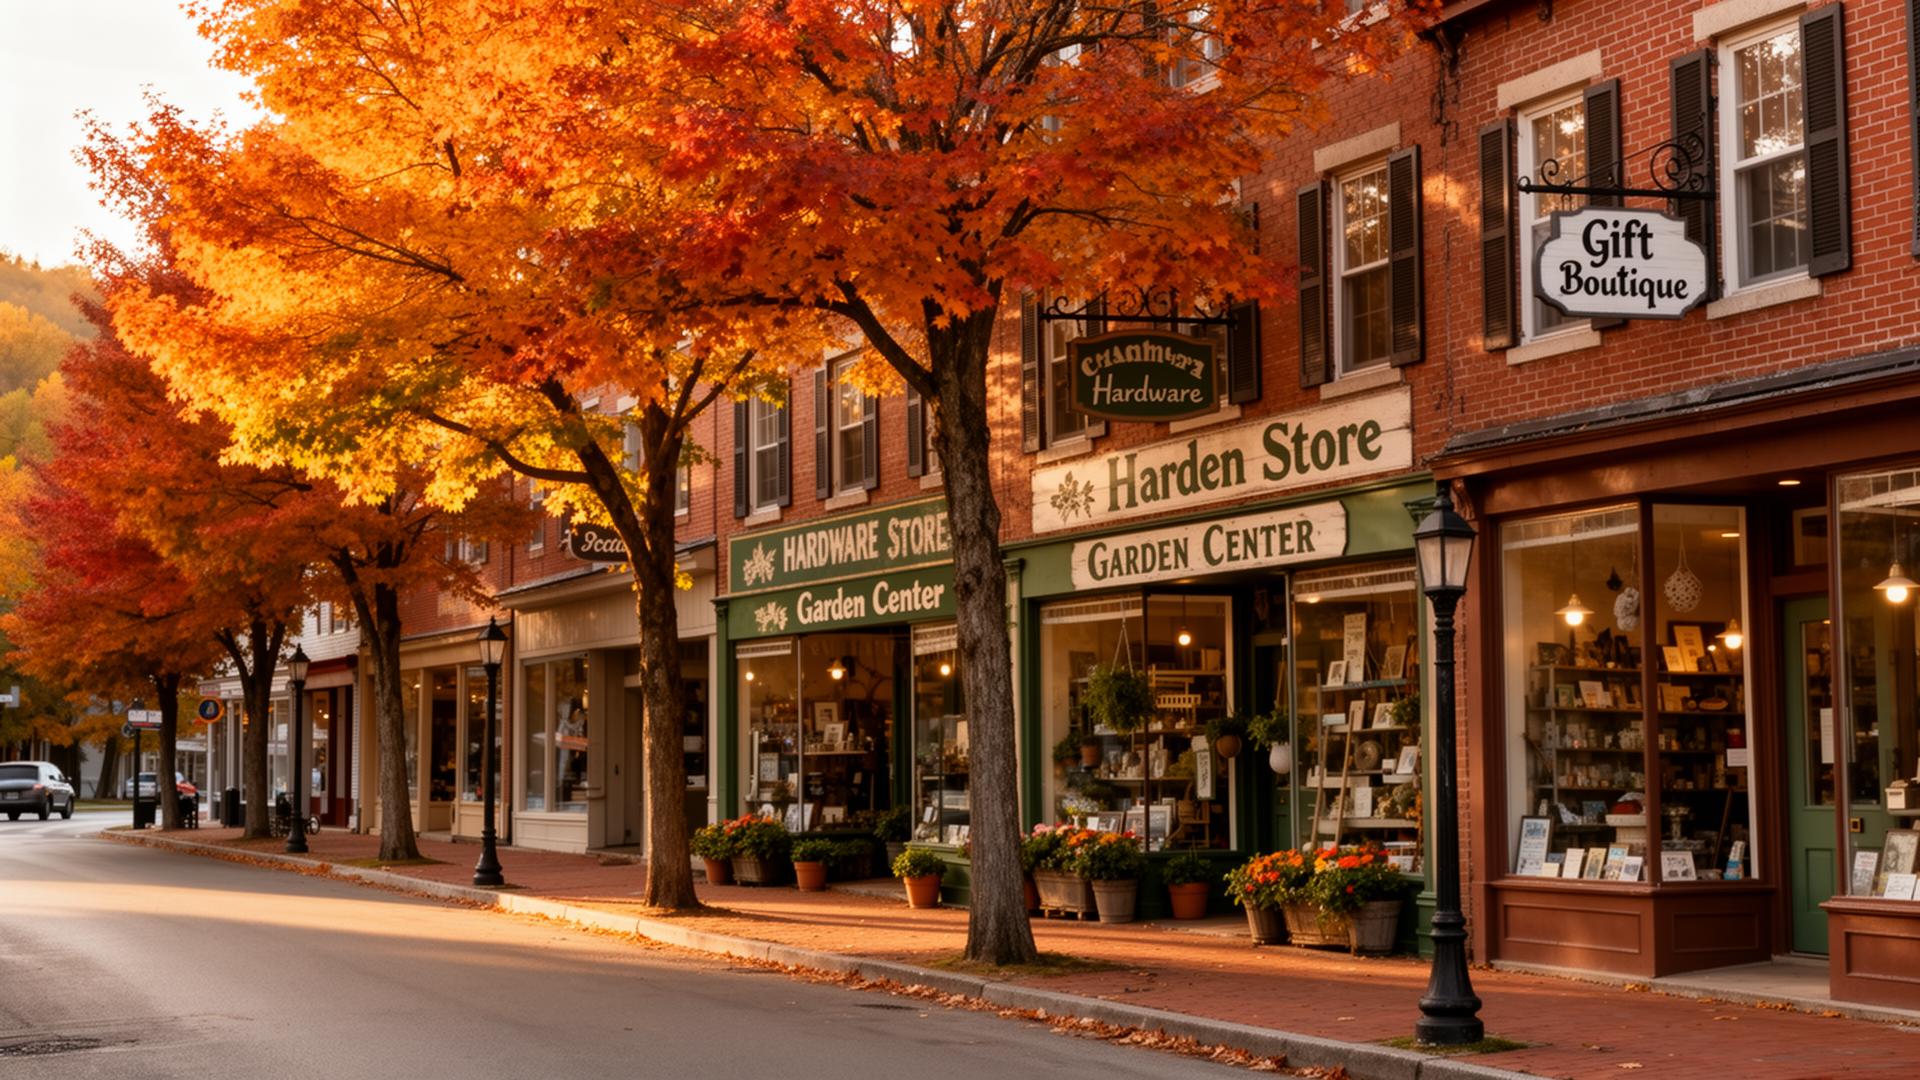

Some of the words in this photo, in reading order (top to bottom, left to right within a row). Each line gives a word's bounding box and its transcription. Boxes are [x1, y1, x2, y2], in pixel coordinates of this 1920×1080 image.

[1582, 218, 1654, 268] Gift
[1559, 260, 1689, 310] Boutique
[1092, 373, 1204, 406] Hardware
[1107, 439, 1247, 512] Harden
[1262, 419, 1382, 481] Store
[783, 519, 879, 573] HARDWARE
[1088, 536, 1190, 581] GARDEN
[1202, 519, 1316, 567] CENTER
[796, 587, 866, 625] Garden
[872, 579, 945, 616] Center
